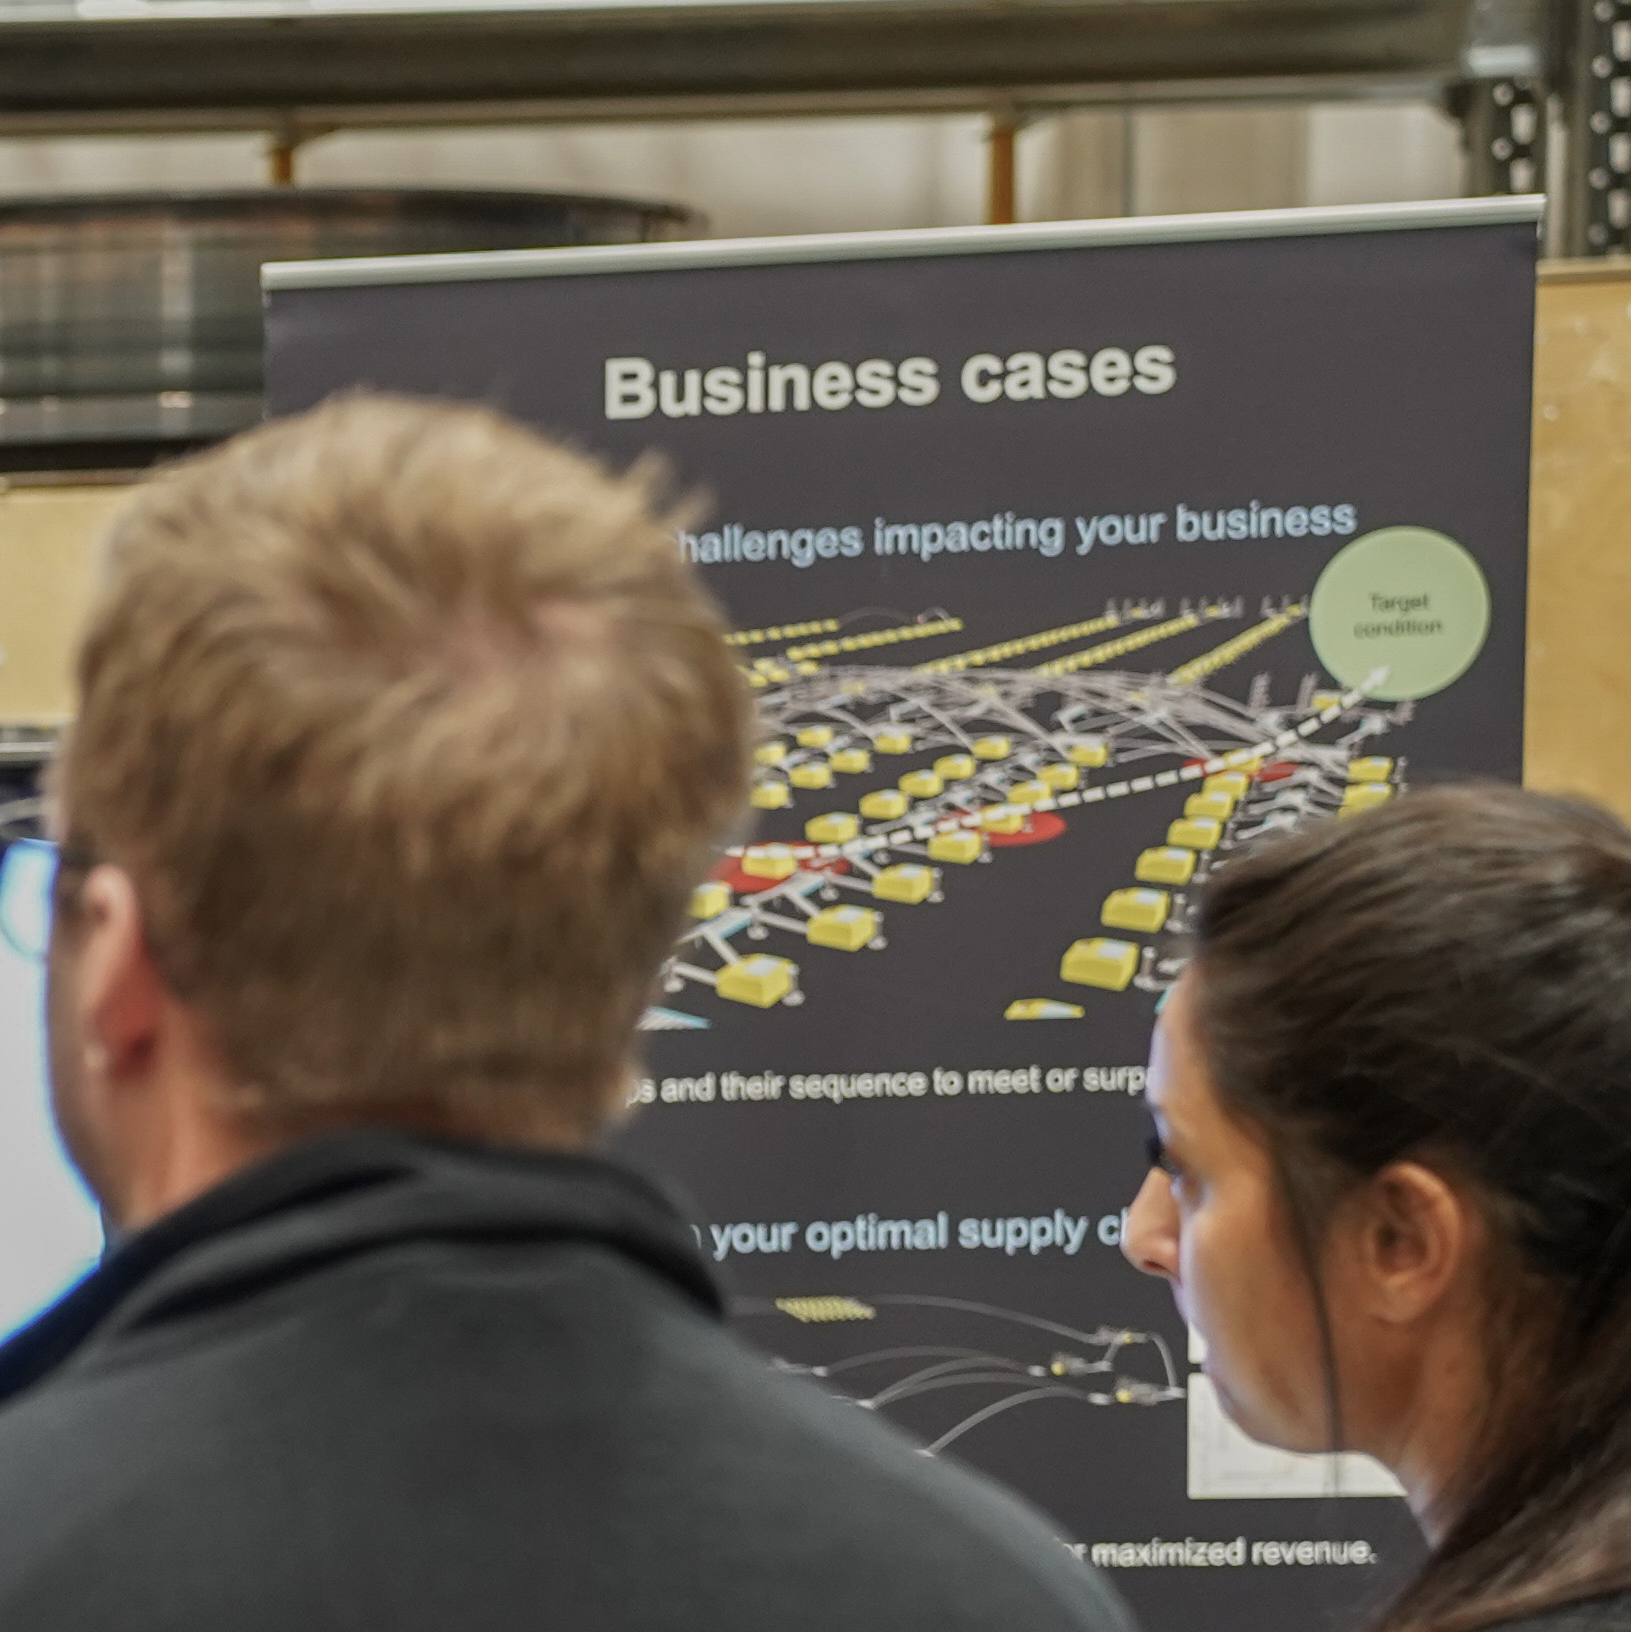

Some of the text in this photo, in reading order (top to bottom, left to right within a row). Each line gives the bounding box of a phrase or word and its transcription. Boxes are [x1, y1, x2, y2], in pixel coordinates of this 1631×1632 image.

[604, 344, 1177, 420] Business cases
[675, 500, 1358, 568] hallenges impacting your business
[1368, 592, 1431, 616] Target
[1353, 619, 1443, 640] condition
[661, 1071, 716, 1103] and
[720, 1070, 786, 1101] their
[789, 1071, 929, 1104] sequence
[933, 1066, 964, 1096] to
[967, 1064, 1041, 1094] meet
[1045, 1067, 1080, 1092] or
[709, 1222, 799, 1261] your
[805, 1211, 949, 1260] optimal
[958, 1207, 1089, 1256] supply
[1091, 1536, 1247, 1567] maximized
[1251, 1540, 1379, 1566] revenue.
